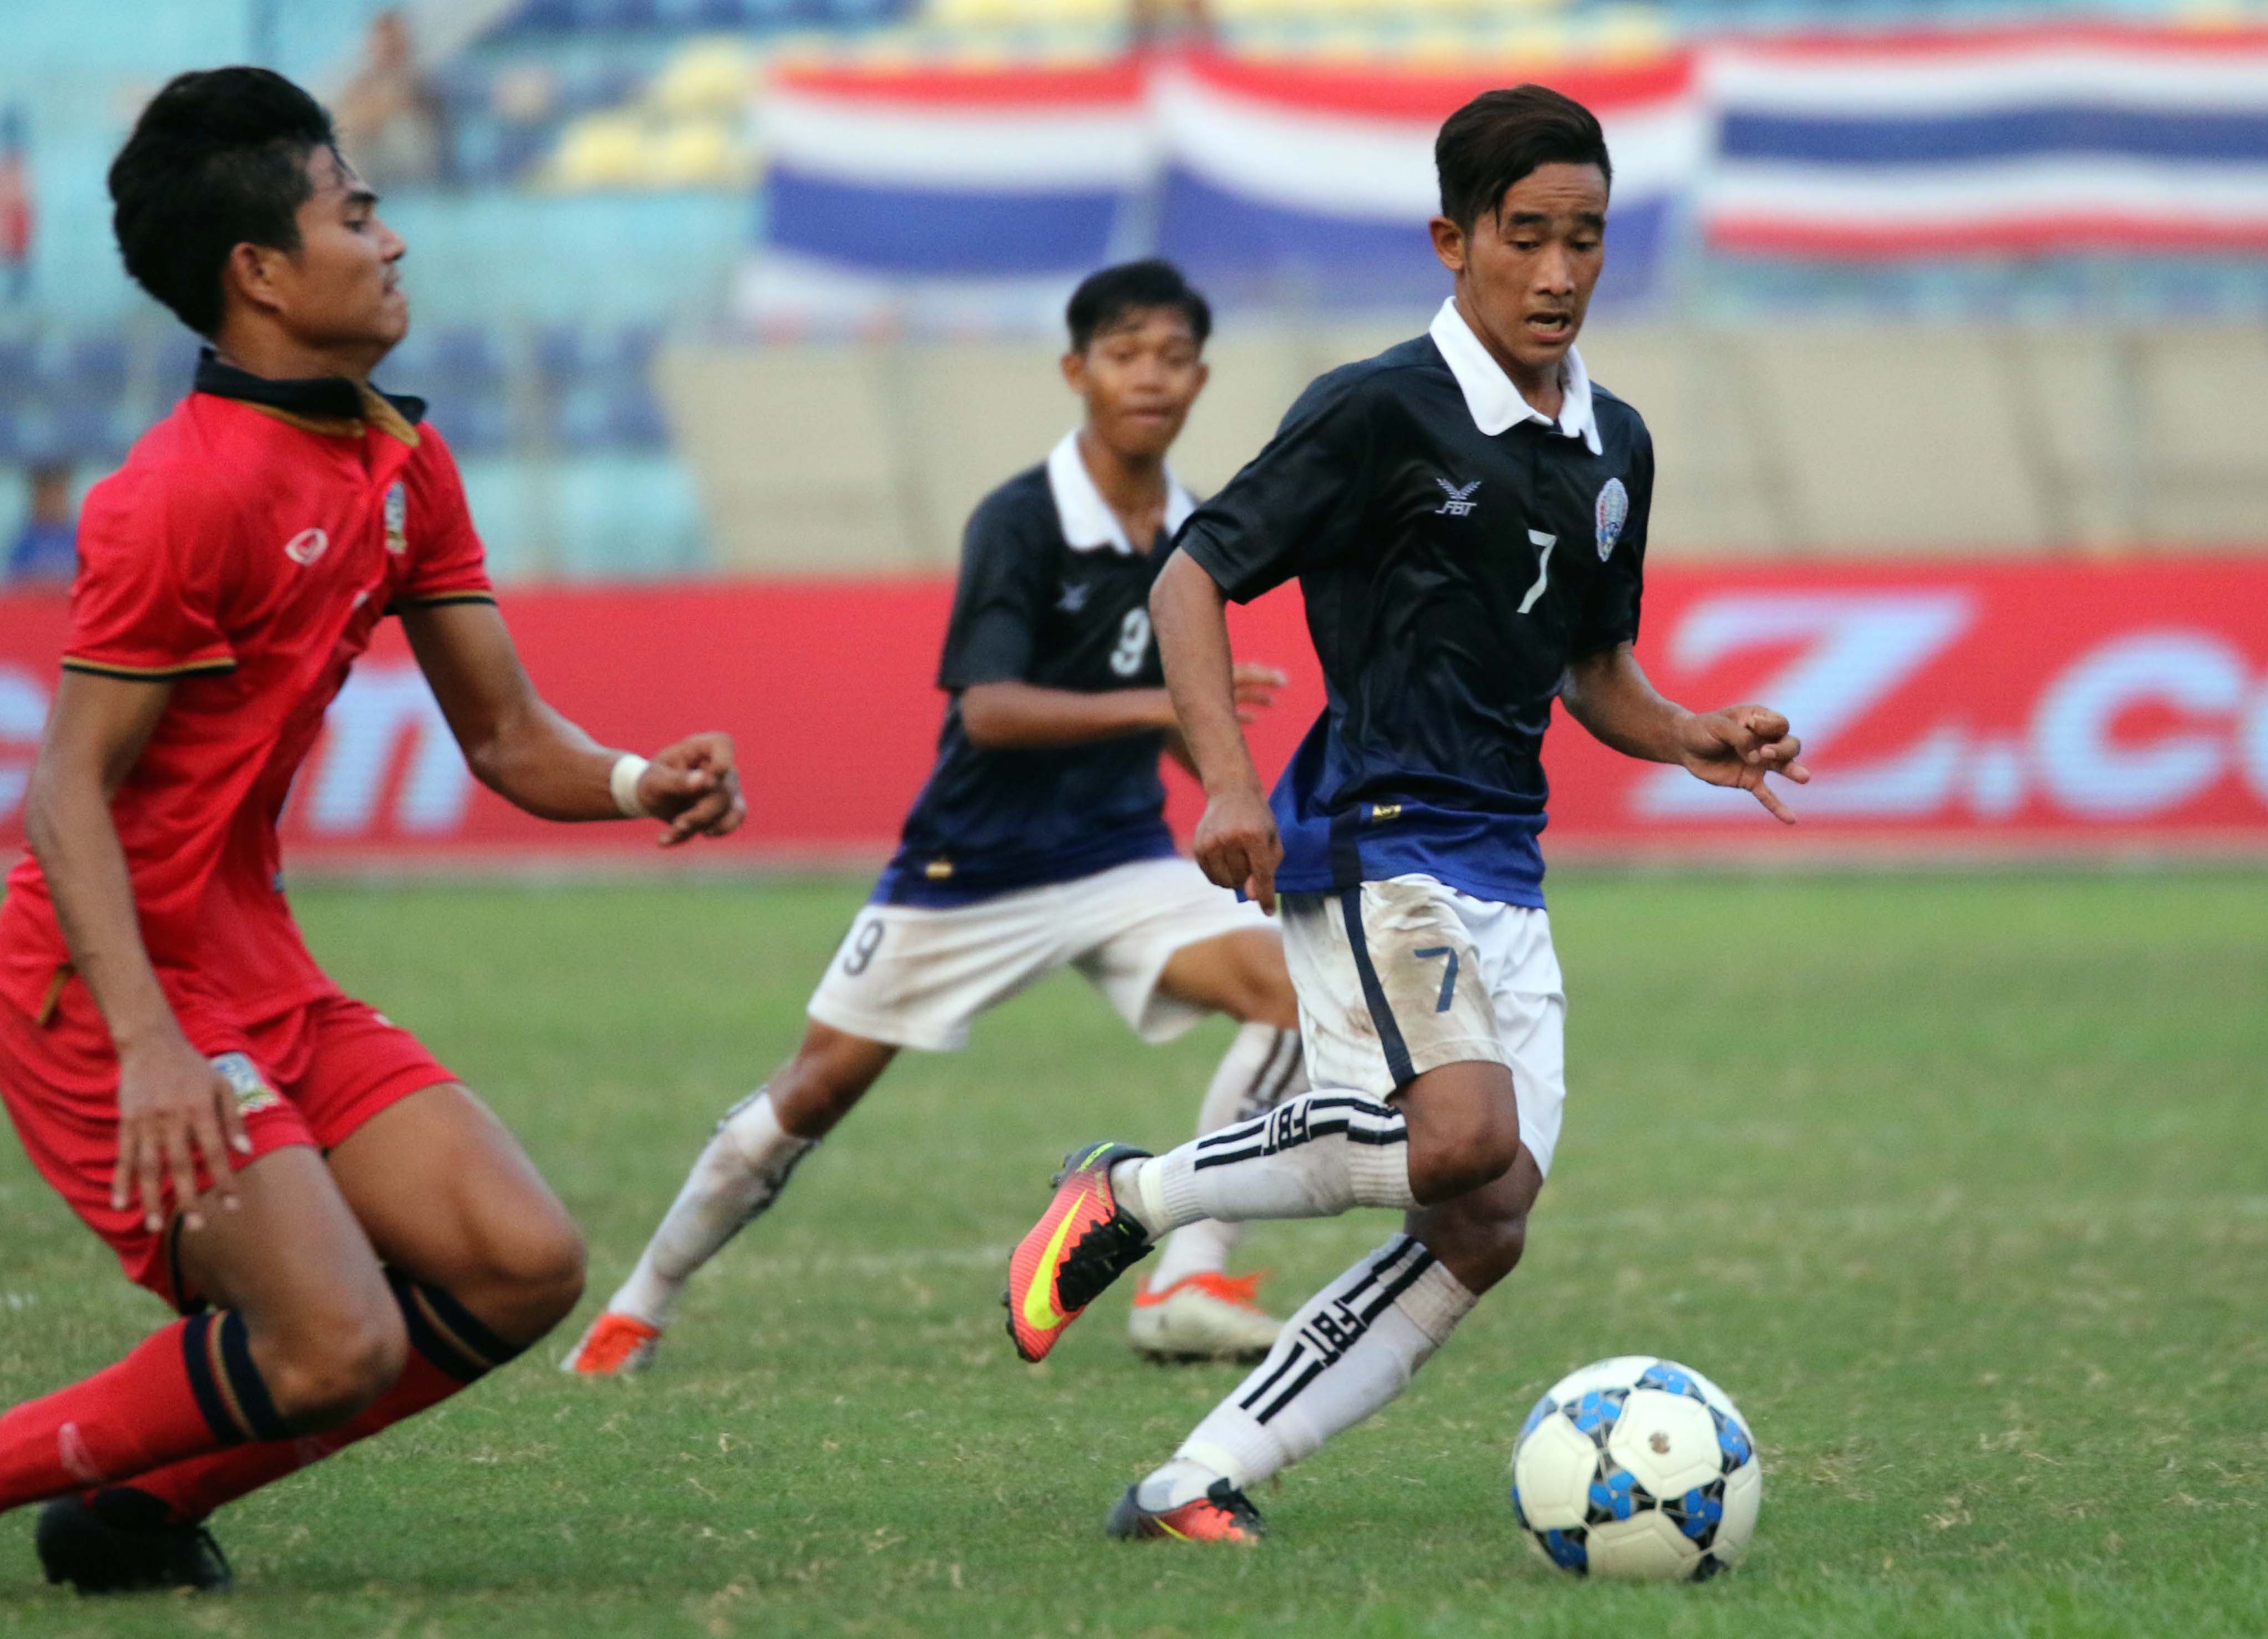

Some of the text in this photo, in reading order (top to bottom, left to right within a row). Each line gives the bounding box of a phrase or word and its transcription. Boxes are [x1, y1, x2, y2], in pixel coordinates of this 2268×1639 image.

[1435, 500, 1477, 517] FBT
[1517, 529, 1557, 614] 7
[1111, 607, 1151, 677] 9
[1633, 591, 2268, 822] Z.c
[843, 919, 884, 976] 9
[1413, 946, 1458, 1013] 7
[1263, 1099, 1311, 1156] FBT
[1300, 1299, 1369, 1368] FBT
